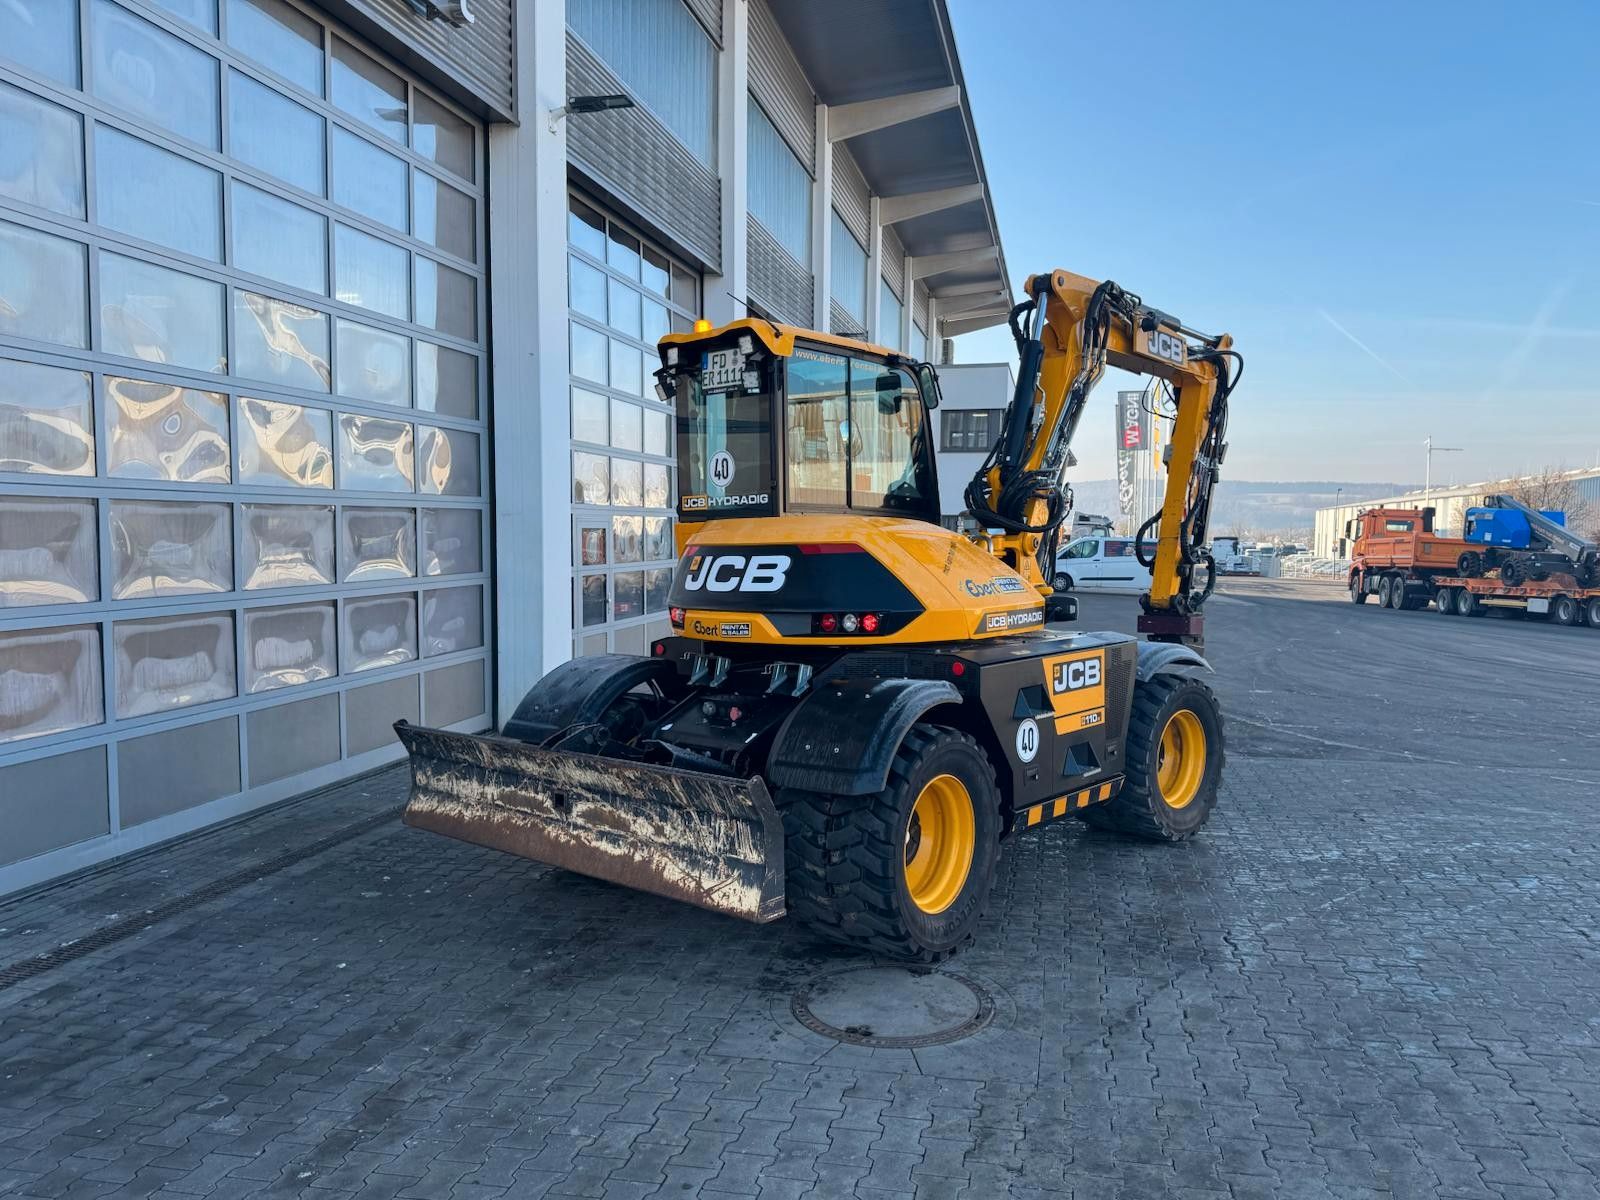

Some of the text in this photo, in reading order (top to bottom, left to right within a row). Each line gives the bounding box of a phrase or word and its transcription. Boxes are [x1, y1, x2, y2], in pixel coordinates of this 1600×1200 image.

[1148, 330, 1183, 362] JCB
[712, 353, 727, 370] FD
[702, 371, 715, 387] ER
[714, 458, 729, 480] 40
[684, 494, 769, 508] JCB HYDRADIG
[684, 555, 791, 592] JCB
[694, 620, 719, 637] Ebert
[988, 611, 1043, 628] JCB HYDRADIG
[1053, 659, 1101, 693] JCB
[1021, 727, 1034, 753] 40
